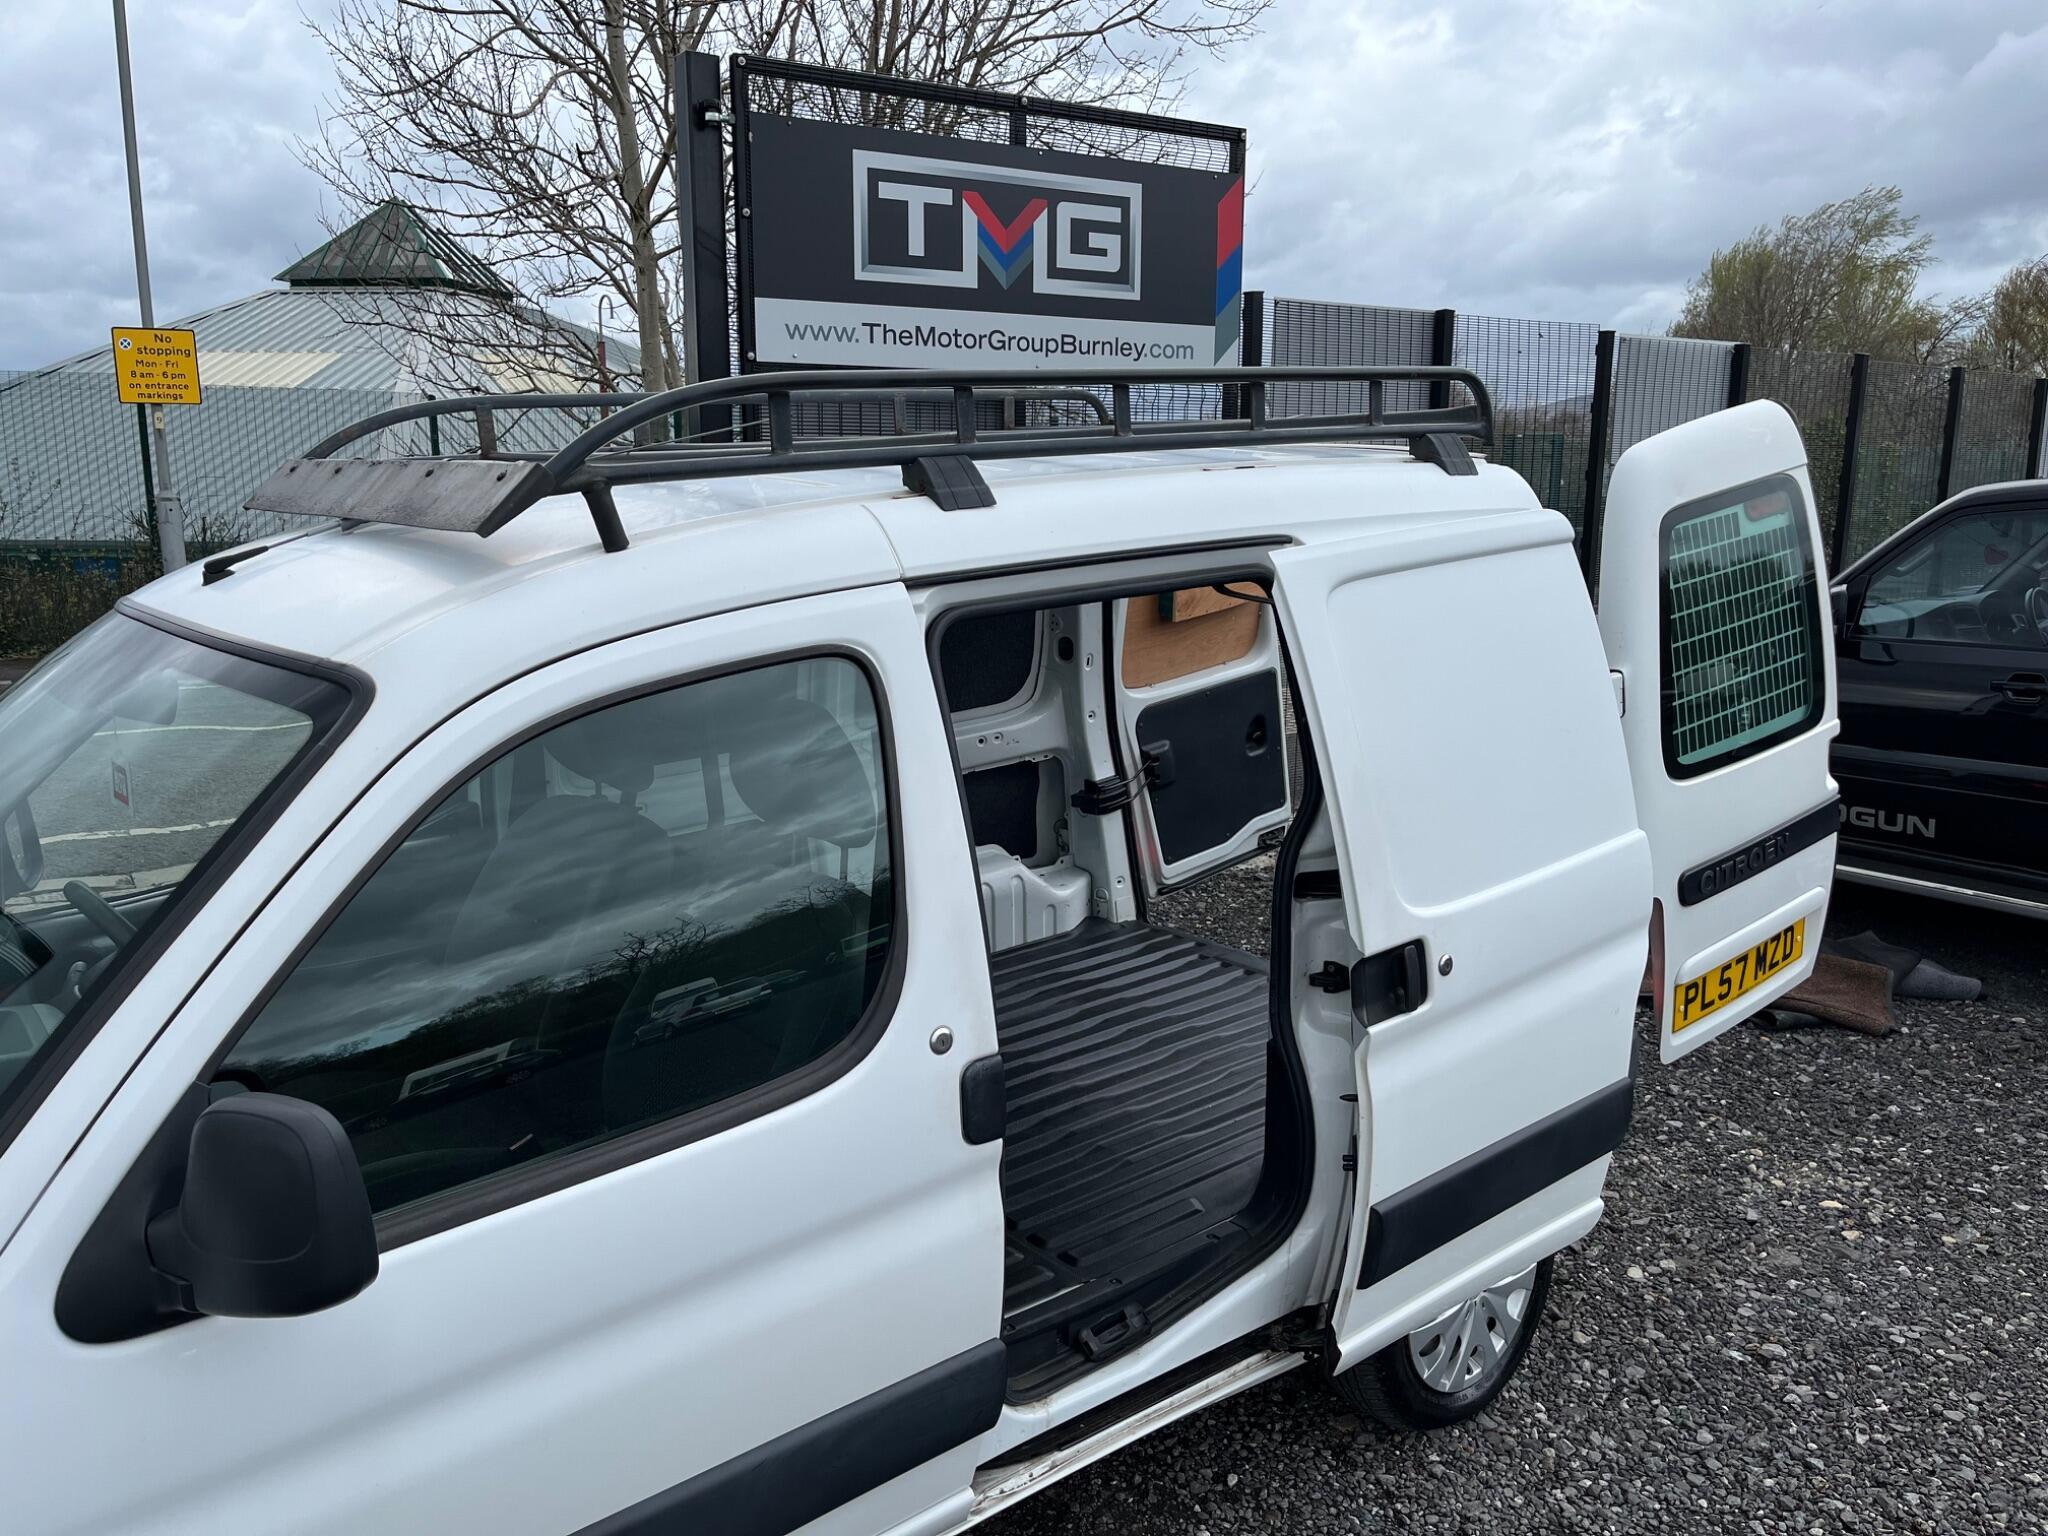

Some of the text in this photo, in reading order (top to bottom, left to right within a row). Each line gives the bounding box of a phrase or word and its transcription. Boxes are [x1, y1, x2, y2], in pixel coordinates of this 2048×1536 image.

[879, 181, 1122, 290] TMG
[154, 334, 172, 343] No
[784, 321, 1194, 361] www.TheMotorGroupBurnley.com
[136, 346, 191, 357] stopping
[135, 360, 157, 368] Mon
[165, 360, 179, 368] Fri
[130, 370, 137, 378] 8
[162, 371, 169, 379] 6
[145, 382, 189, 390] entrance
[137, 392, 184, 400] markings
[1683, 925, 1795, 1021] PL57 MZD
